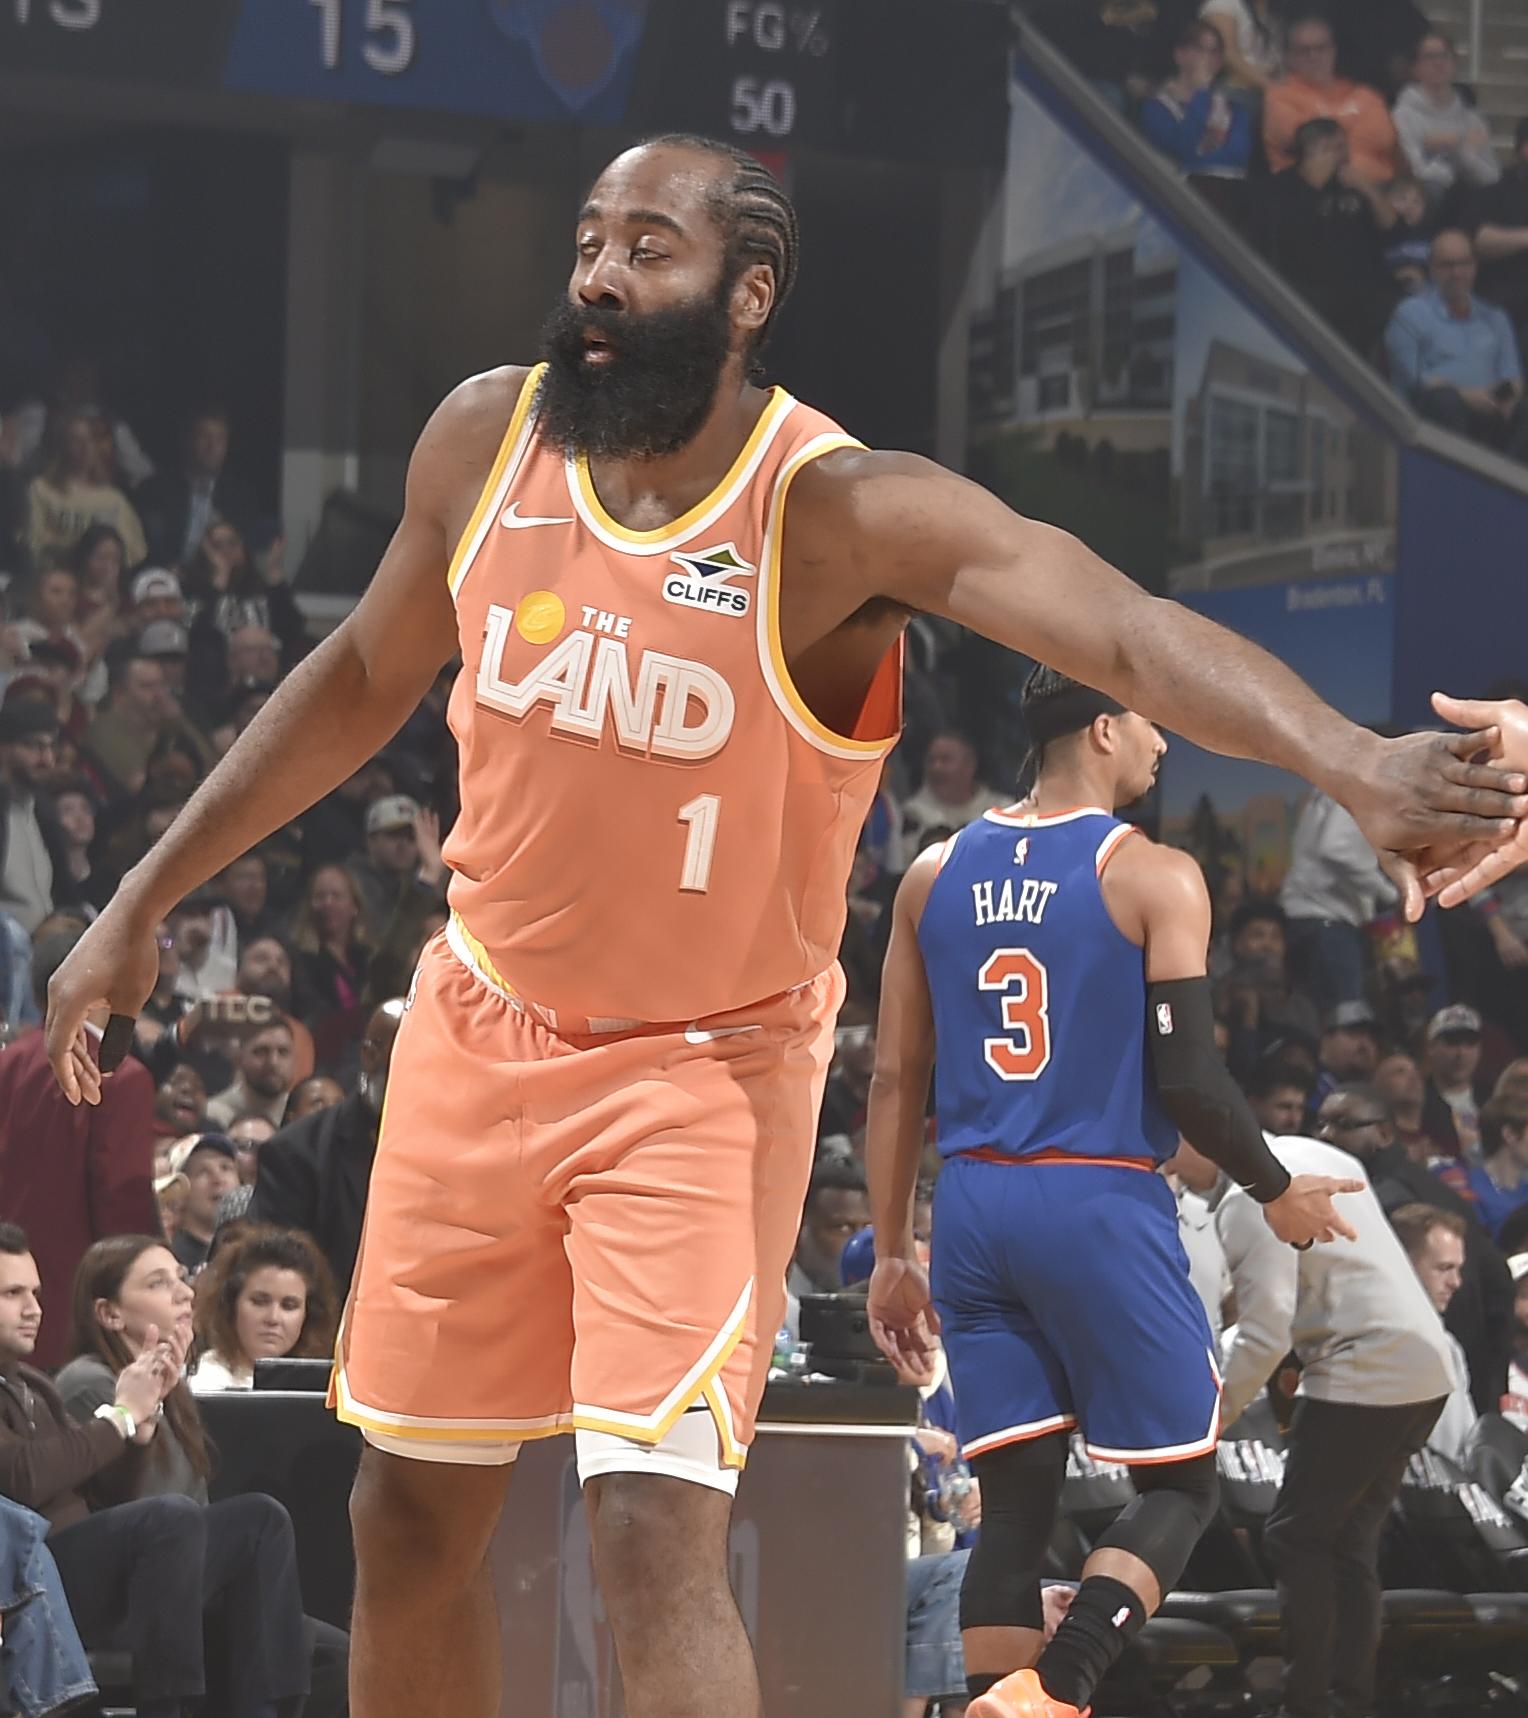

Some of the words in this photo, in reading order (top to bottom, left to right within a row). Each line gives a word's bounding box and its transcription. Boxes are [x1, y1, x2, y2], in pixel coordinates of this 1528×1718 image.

[308, 0, 412, 73] 15
[731, 79, 794, 135] 50
[581, 605, 632, 638] THE
[667, 581, 747, 611] CLIFFS
[475, 603, 736, 768] LAND
[678, 792, 722, 894] 1
[972, 879, 1058, 926] HART
[979, 949, 1050, 1080] 3
